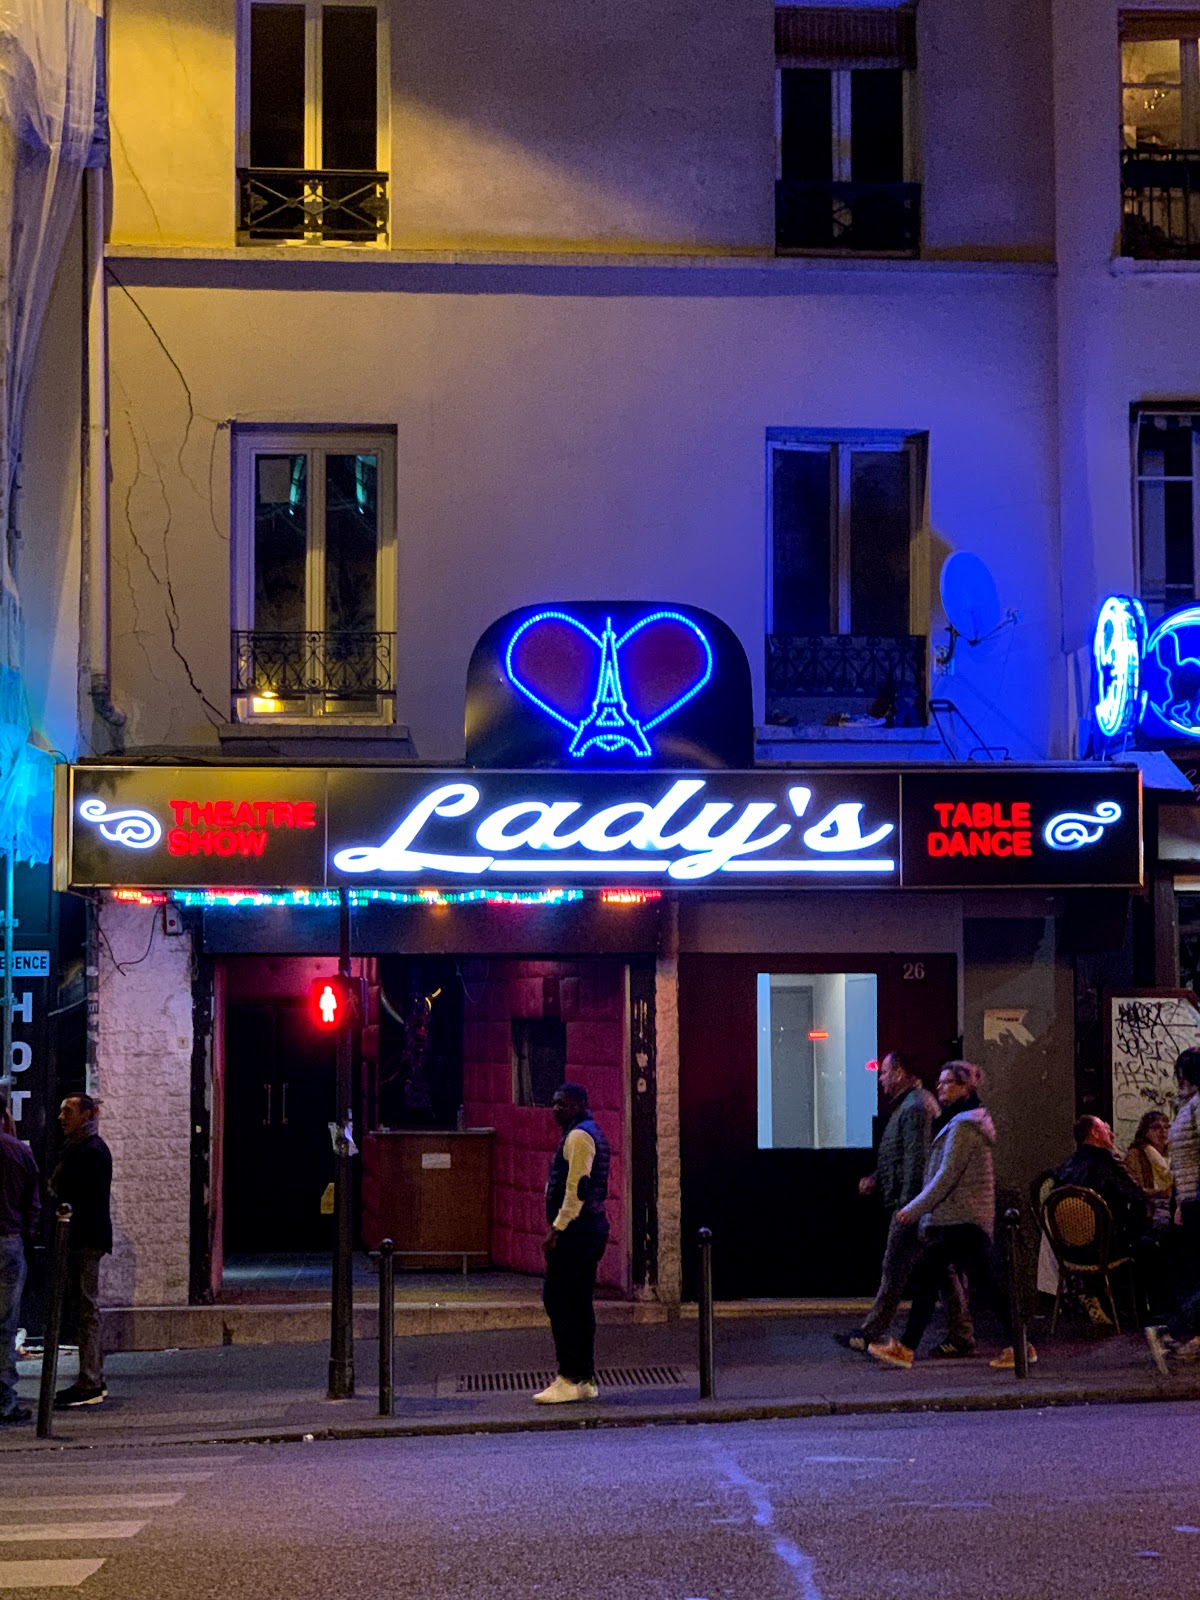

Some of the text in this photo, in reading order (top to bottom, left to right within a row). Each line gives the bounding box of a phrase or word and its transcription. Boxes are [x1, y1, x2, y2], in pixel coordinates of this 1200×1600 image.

[169, 800, 316, 828] THEATRE
[934, 802, 1031, 828] TABLE
[333, 779, 895, 880] Lady's
[168, 829, 268, 857] SHOW
[928, 831, 1032, 857] DANCE
[0, 956, 47, 970] EENCE
[903, 962, 925, 980] 26
